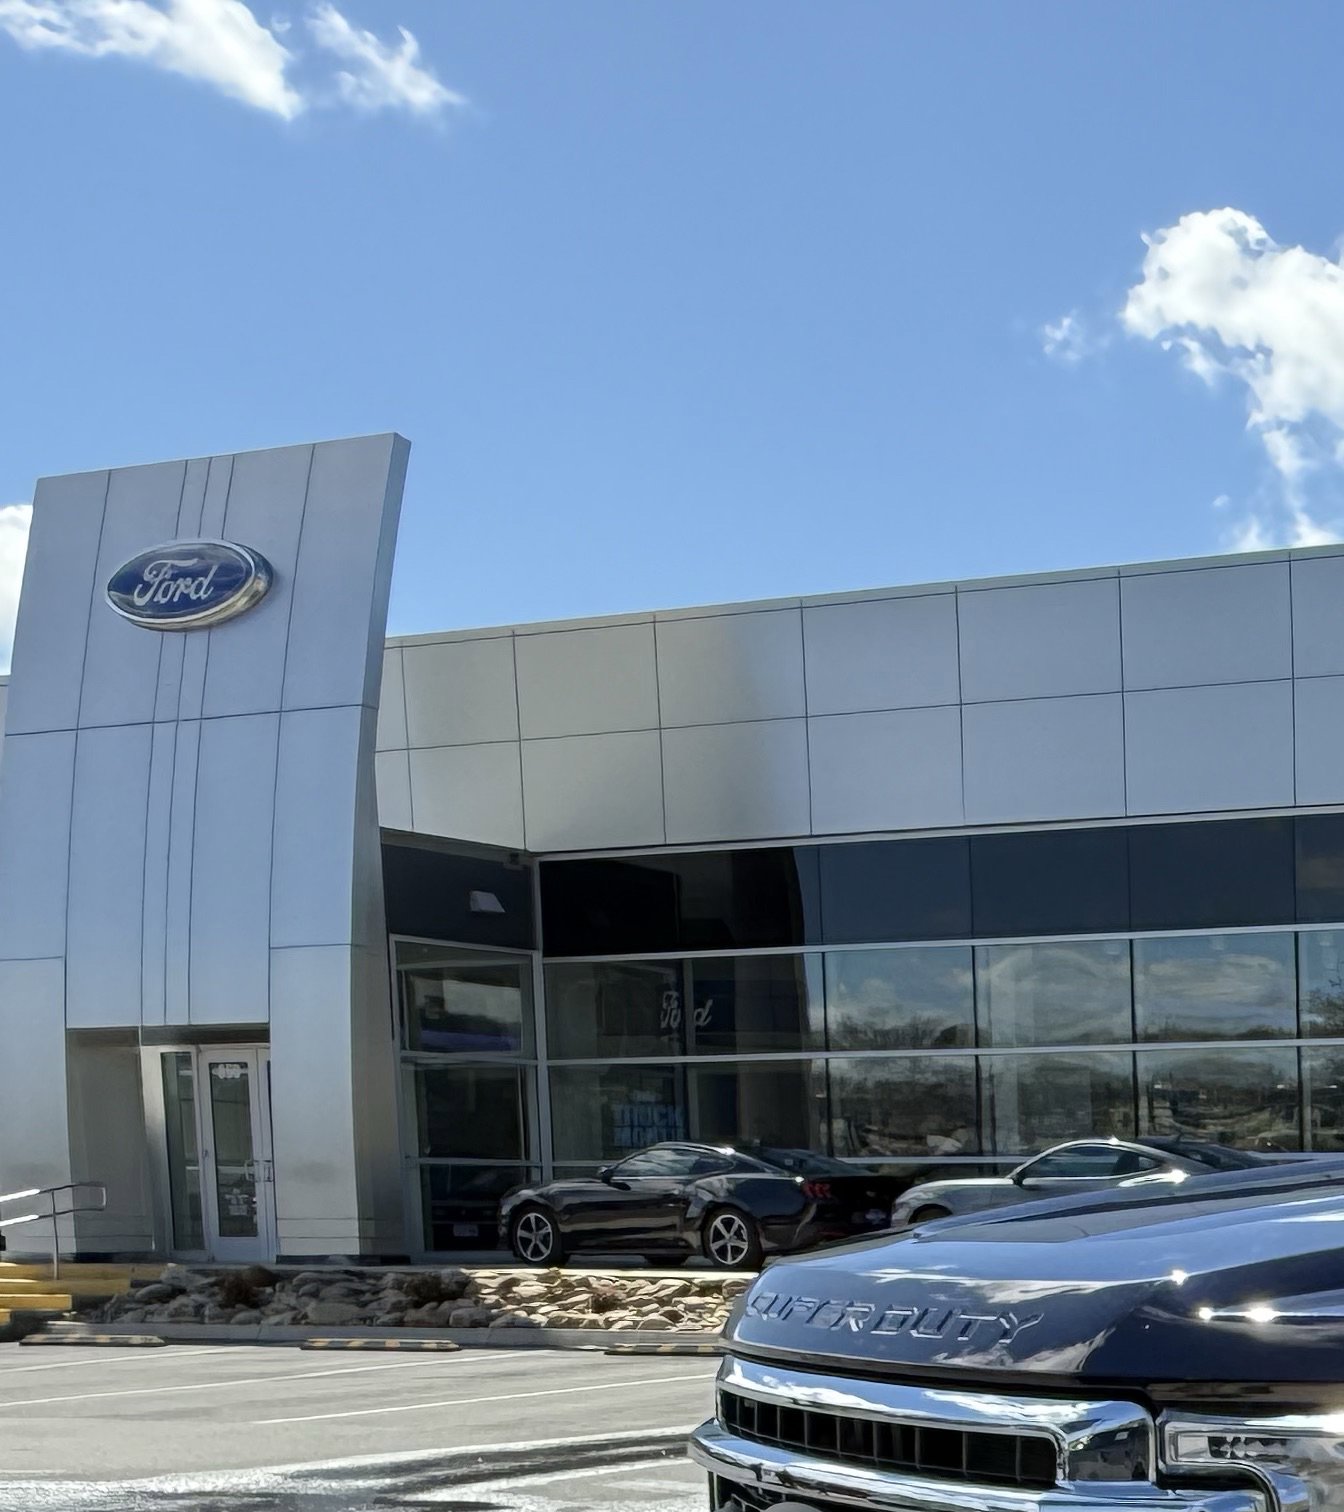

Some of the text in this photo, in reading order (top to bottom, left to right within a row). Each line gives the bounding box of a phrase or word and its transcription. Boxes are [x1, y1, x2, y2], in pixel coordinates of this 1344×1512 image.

[133, 557, 219, 607] Ford
[659, 989, 714, 1029] Fod
[869, 1304, 1046, 1344] DUTY
